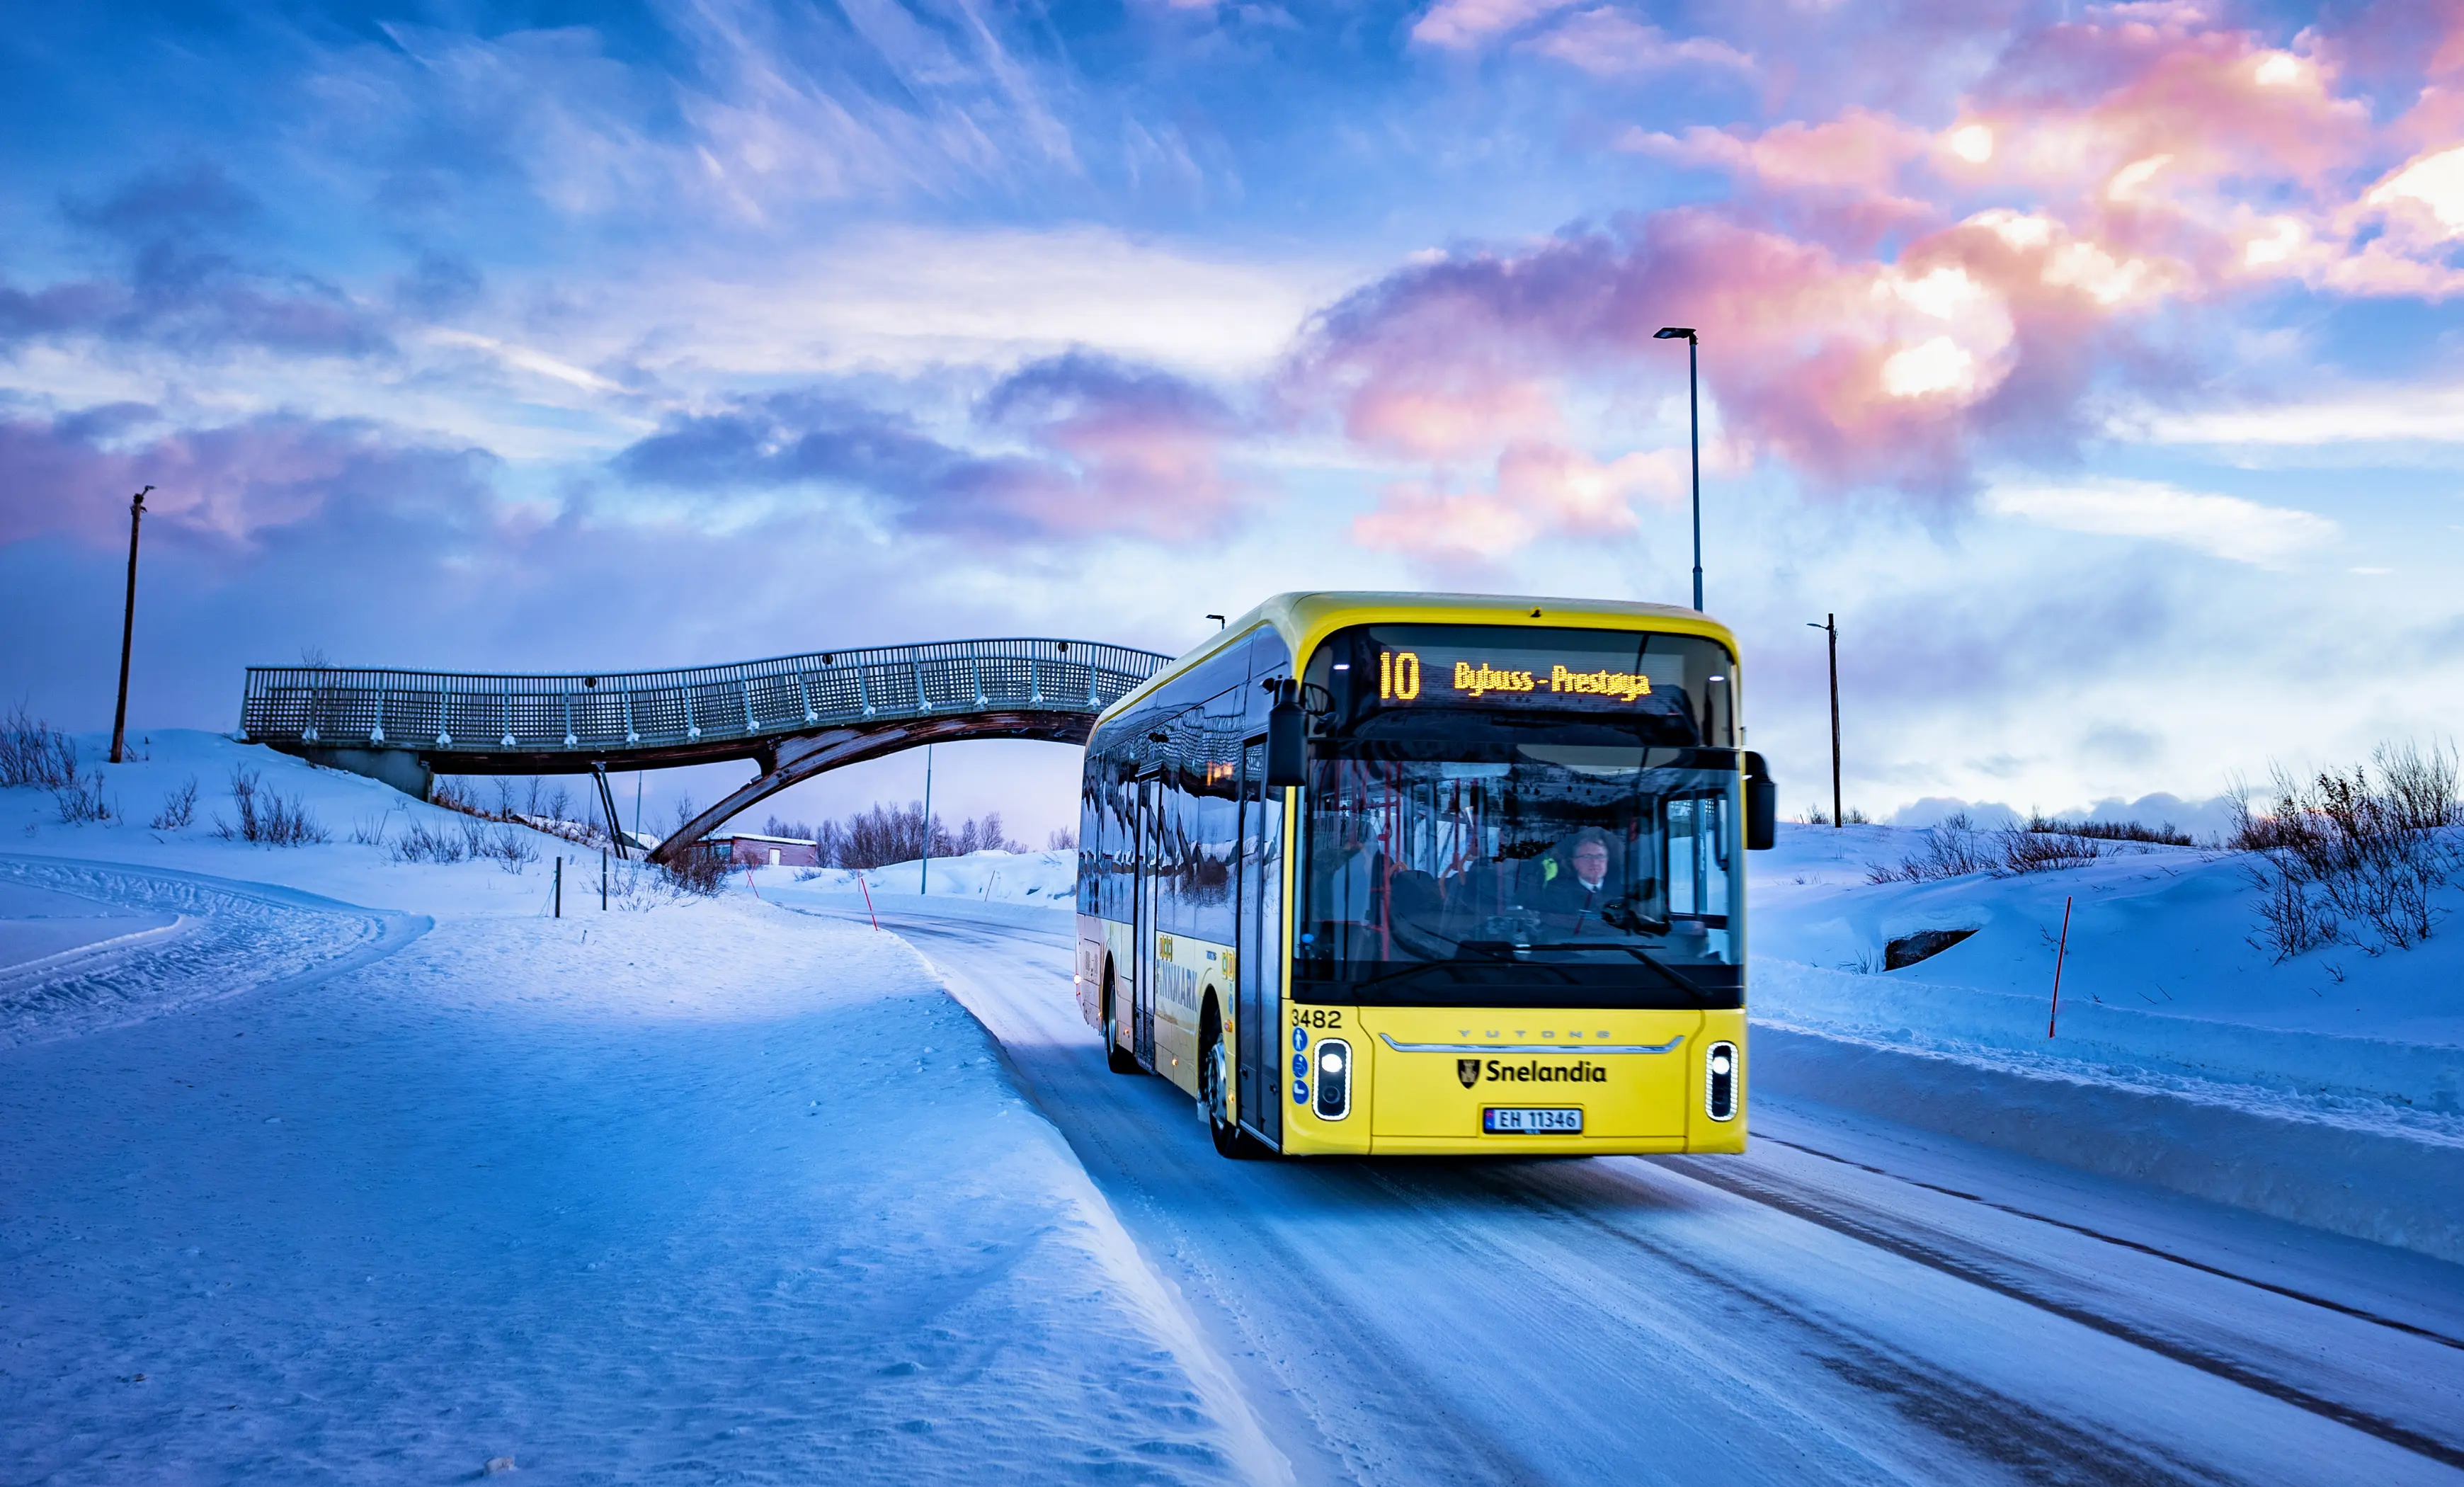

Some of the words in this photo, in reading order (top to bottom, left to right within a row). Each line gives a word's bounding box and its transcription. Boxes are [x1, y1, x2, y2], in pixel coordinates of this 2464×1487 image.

[1380, 651, 1419, 700] 10
[1454, 661, 1534, 697] Bybuss
[1291, 1008, 1342, 1029] 3482
[1458, 1030, 1611, 1039] YUTONG
[1486, 1060, 1608, 1083] Snelandia
[1500, 1111, 1522, 1127] EH
[1529, 1111, 1576, 1128] 11346
